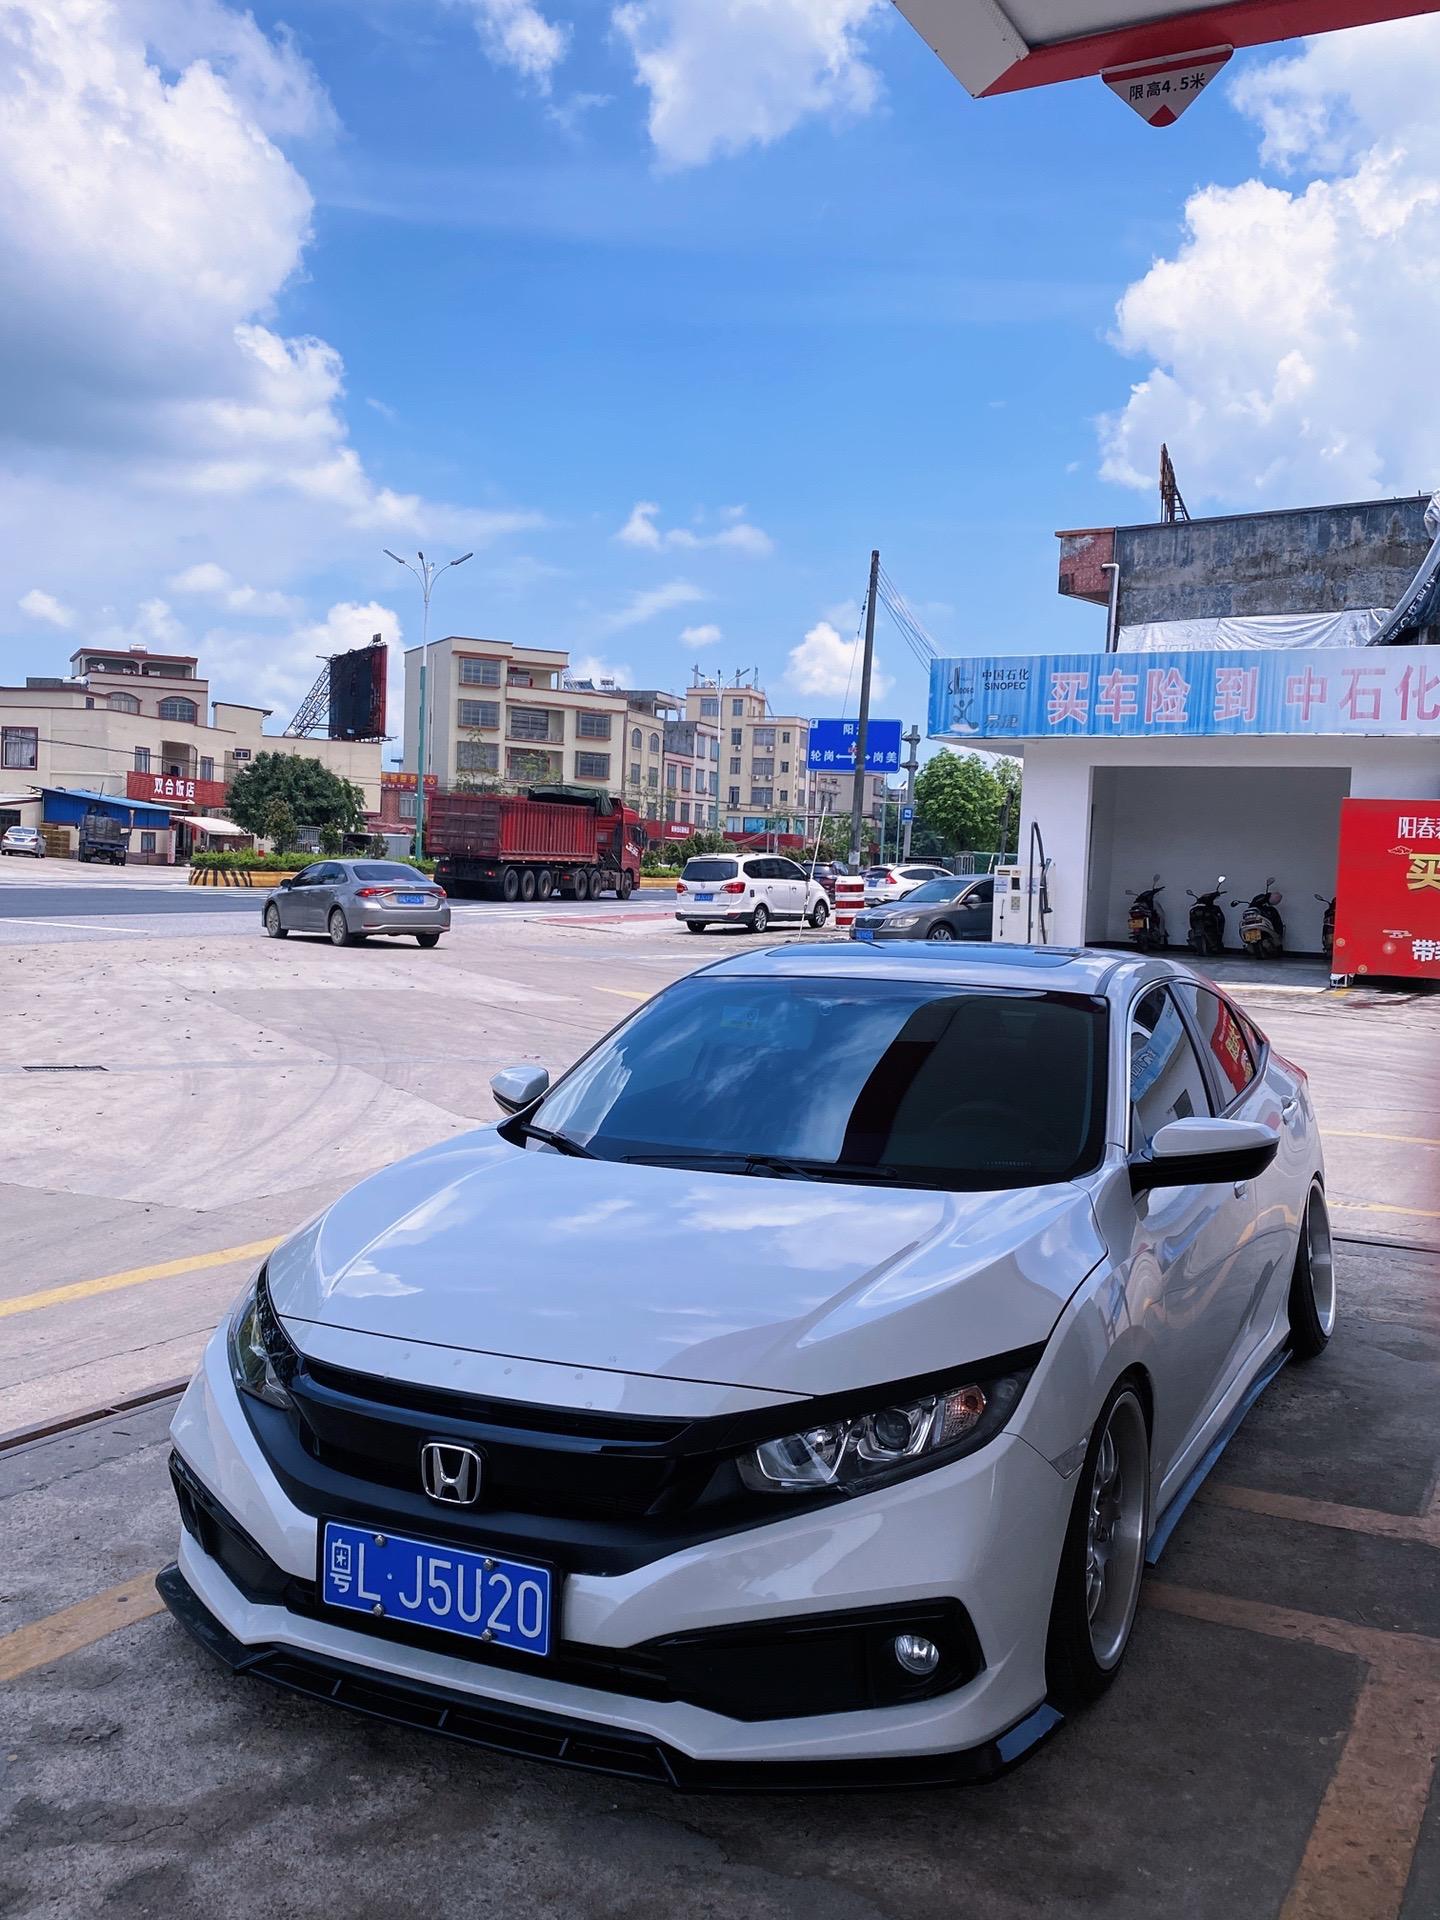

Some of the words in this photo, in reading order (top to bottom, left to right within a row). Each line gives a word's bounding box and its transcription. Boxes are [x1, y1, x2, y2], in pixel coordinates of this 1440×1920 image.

[1129, 72, 1206, 101] 限高4.5米
[982, 668, 1030, 681] 中国石化
[984, 681, 1027, 691] SINOPEC
[873, 751, 897, 763] 岗美
[154, 777, 195, 798] 双合饭店
[1397, 816, 1440, 839] 阳春
[1412, 939, 1440, 962] 带
